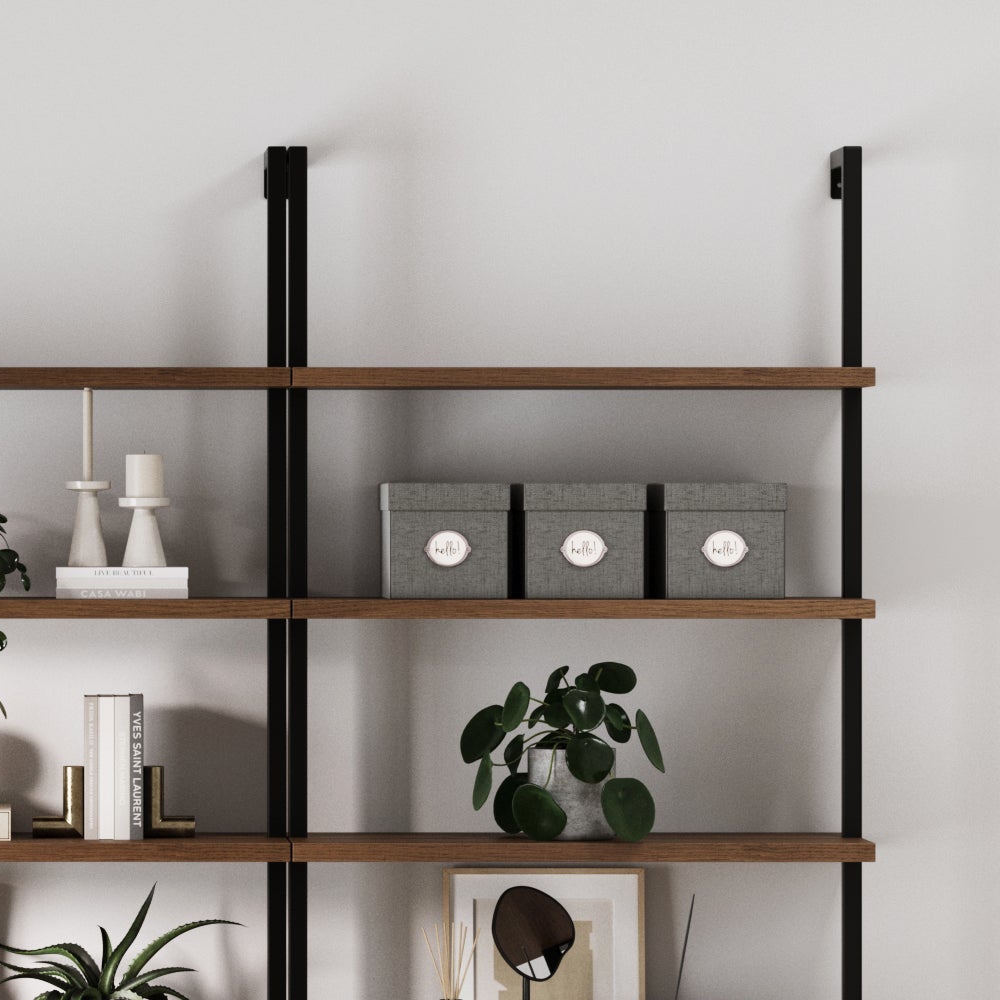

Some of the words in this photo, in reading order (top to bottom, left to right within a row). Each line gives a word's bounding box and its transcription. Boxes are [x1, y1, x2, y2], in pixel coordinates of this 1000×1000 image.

[80, 589, 112, 598] CASA
[115, 589, 147, 598] WABI
[132, 711, 142, 739] YVES
[132, 742, 142, 774] SAINT
[132, 777, 142, 828] LAURENT
